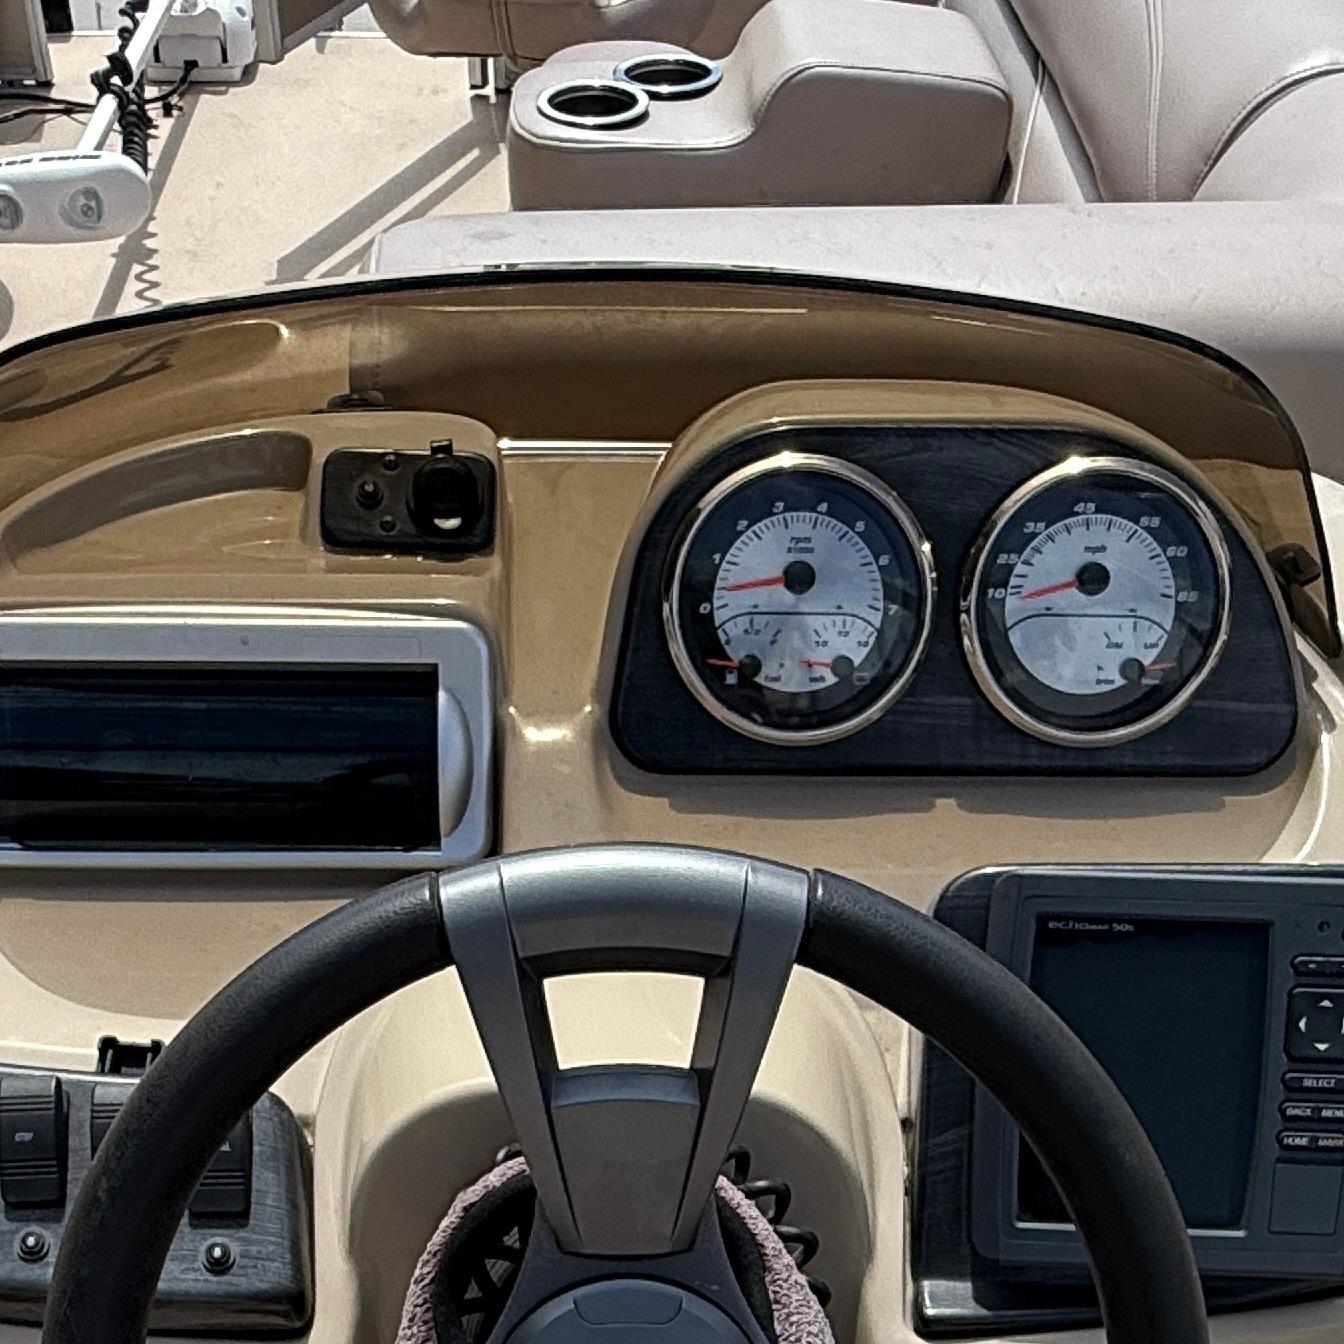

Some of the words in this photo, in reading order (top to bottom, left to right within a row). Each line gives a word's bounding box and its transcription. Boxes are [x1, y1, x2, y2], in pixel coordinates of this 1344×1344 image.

[772, 502, 785, 512] 3
[816, 502, 829, 512] 4
[1073, 502, 1096, 513] 45
[736, 520, 749, 532] 2
[855, 520, 867, 532] 5
[1023, 521, 1046, 533] 35
[1166, 546, 1189, 557] 60
[713, 553, 721, 564] 1
[879, 554, 891, 566] 6
[997, 553, 1019, 564] 25
[987, 588, 1006, 599] 10
[699, 602, 712, 614] 0
[888, 604, 900, 616] 7
[1302, 1078, 1336, 1088] SELECT
